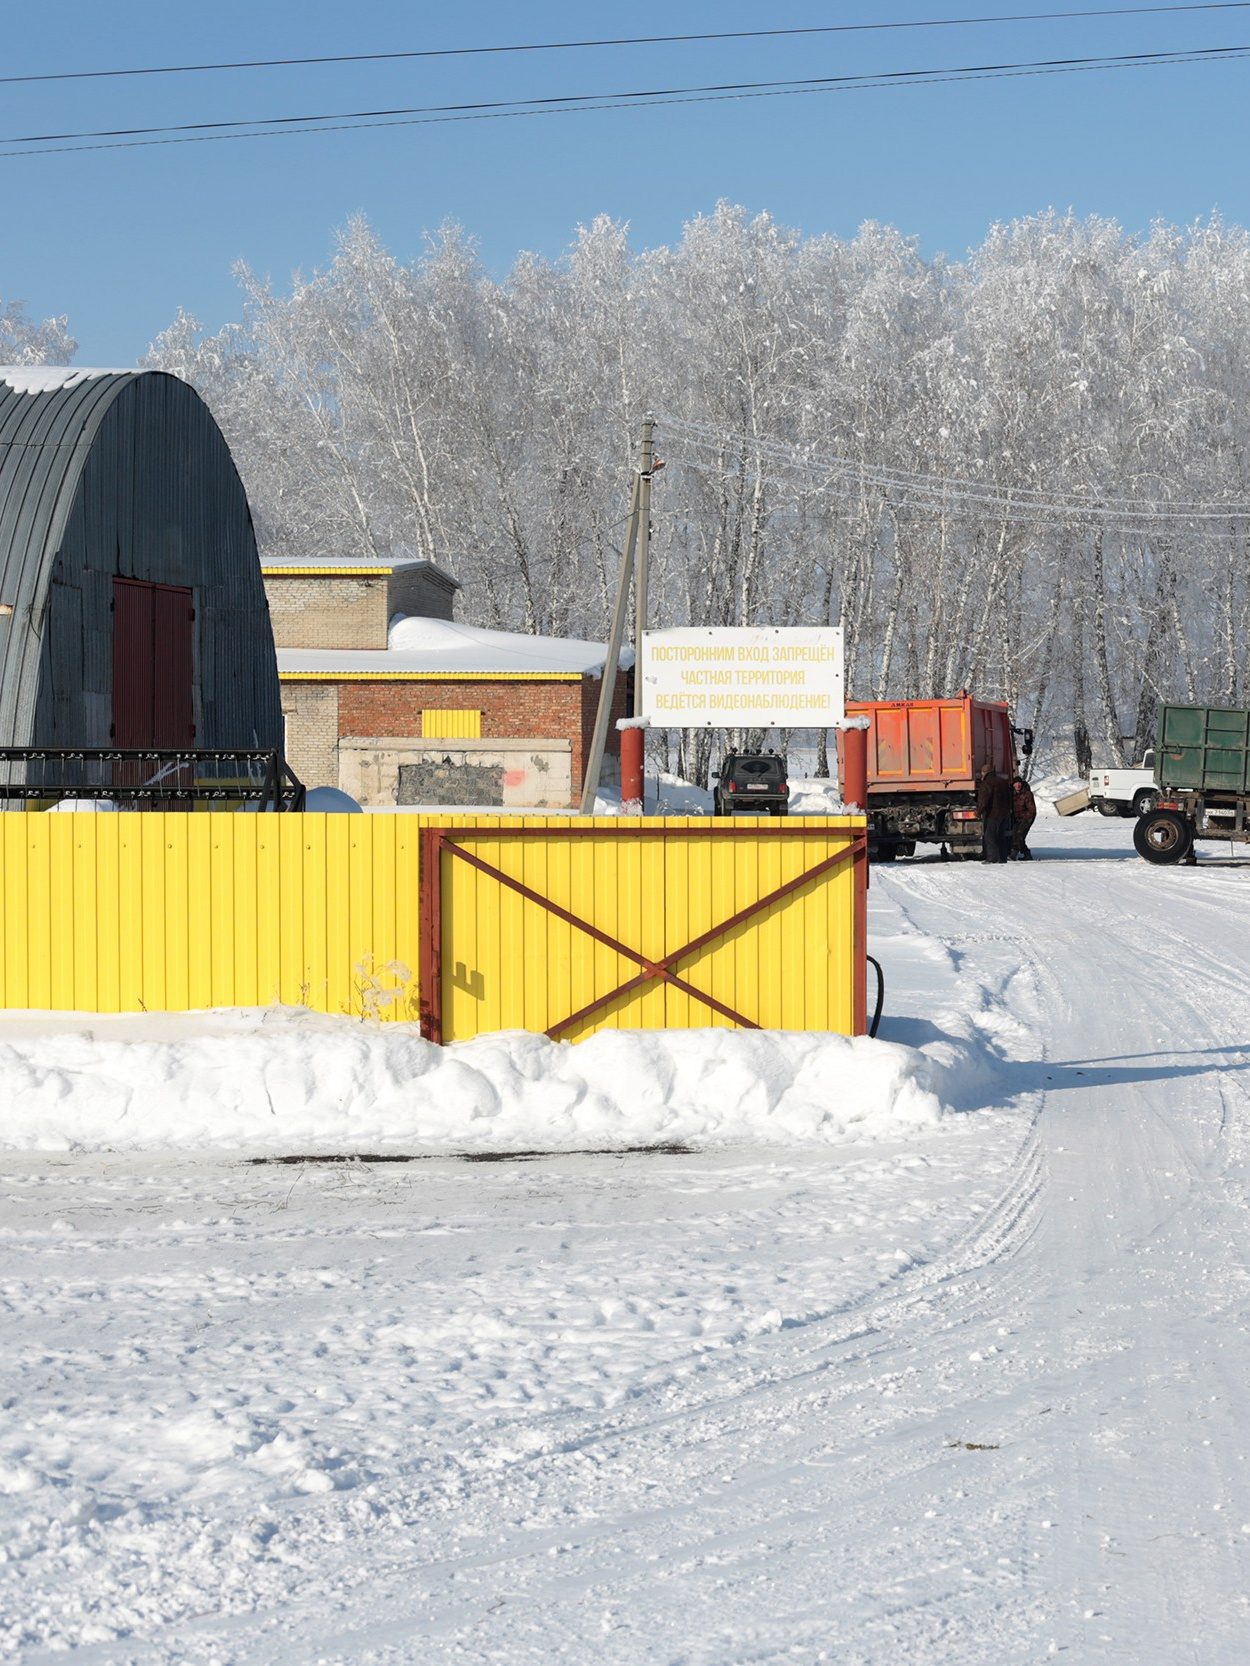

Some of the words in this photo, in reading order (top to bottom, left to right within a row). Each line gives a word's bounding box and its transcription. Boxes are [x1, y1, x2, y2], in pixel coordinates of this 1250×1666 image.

[651, 646, 735, 661] ПОСТОРОННИМ
[738, 646, 770, 662] ВХОД
[772, 644, 835, 663] ЗАПРЕЩЁН
[681, 670, 732, 685] ЧАСТНАЯ
[735, 670, 806, 685] ТЕРРИТОРИЯ
[656, 691, 707, 710] ВЕДЁТСЯ
[709, 693, 831, 710] ВИДЕОНАБЛЮДЕНИЕ!
